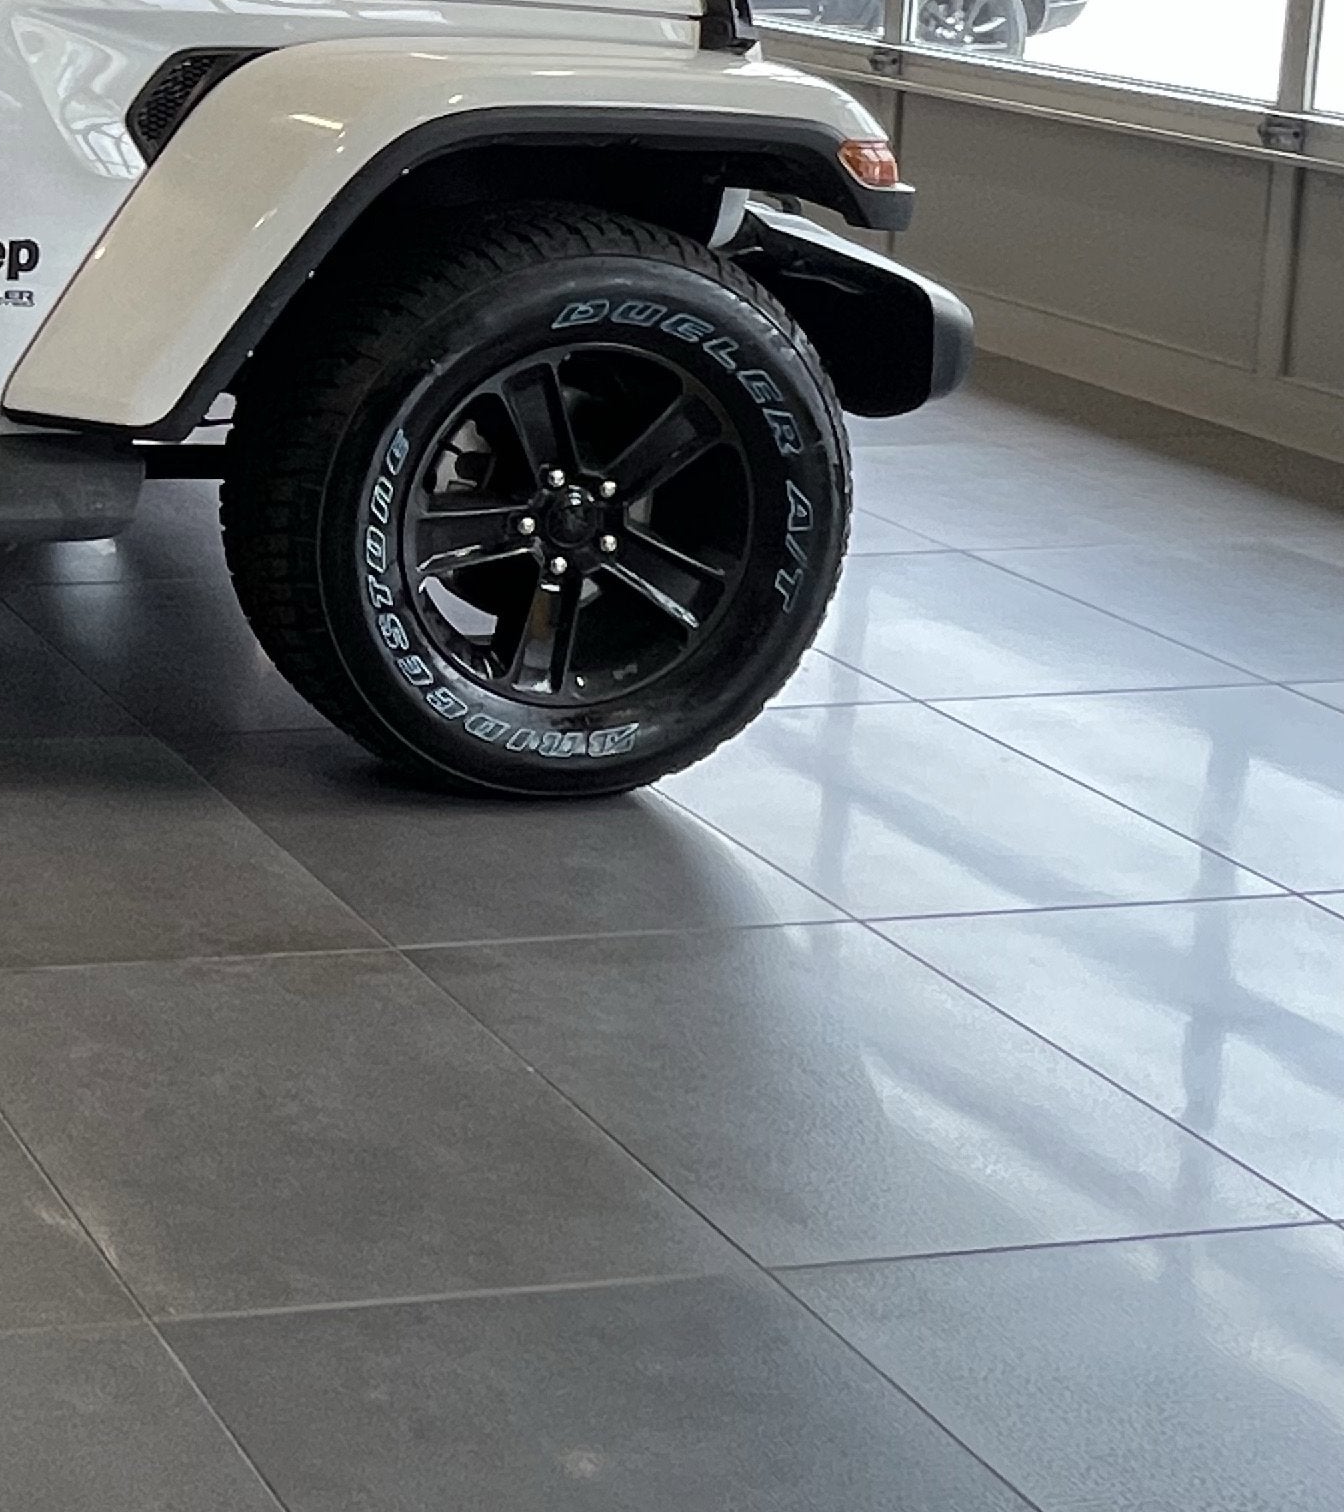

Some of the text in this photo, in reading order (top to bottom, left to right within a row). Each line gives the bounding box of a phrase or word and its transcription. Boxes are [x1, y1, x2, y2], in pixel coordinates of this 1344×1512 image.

[362, 427, 640, 759] BRIDGESTONE
[551, 299, 814, 614] DUELER A/T
